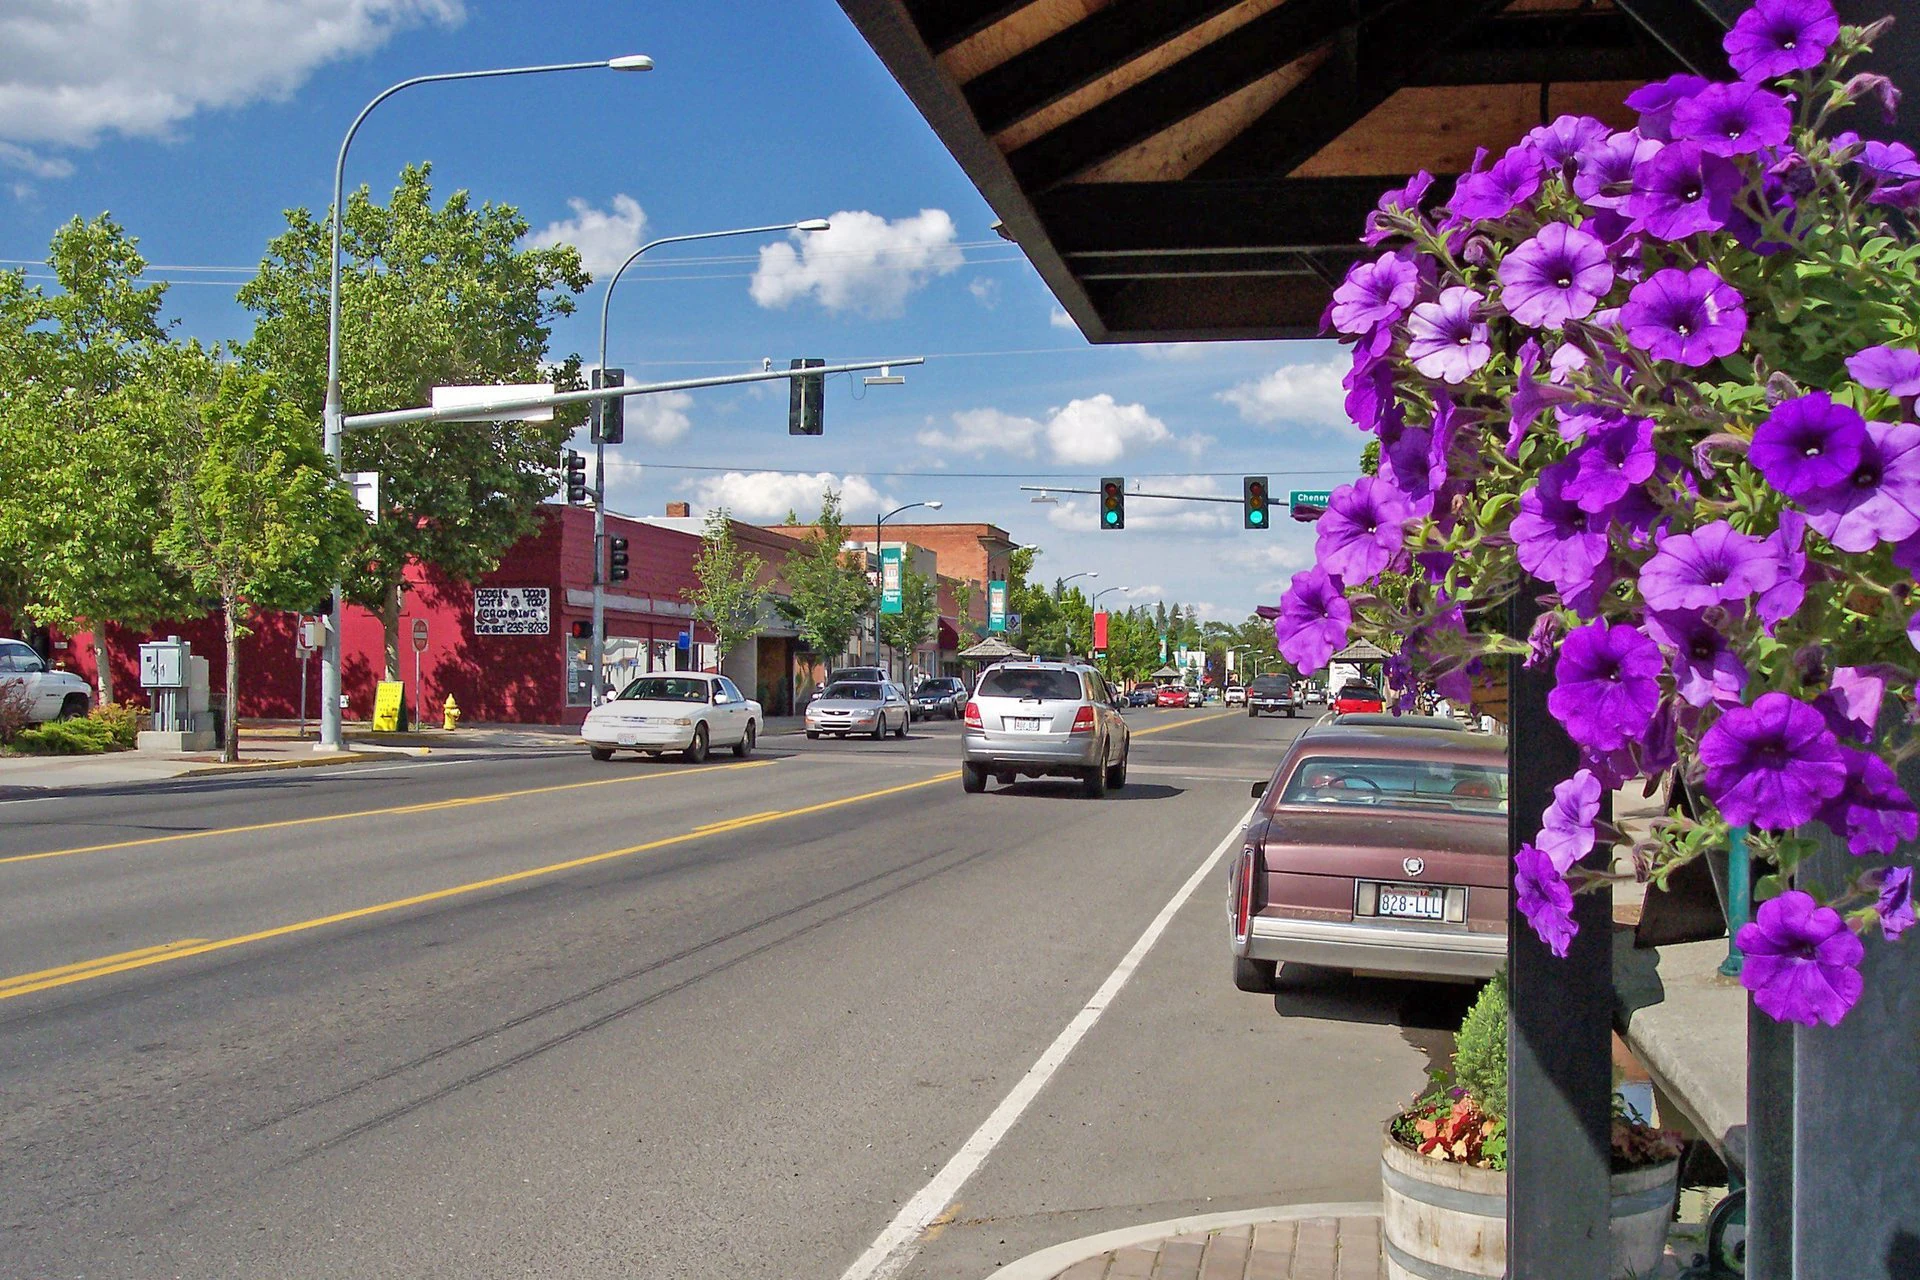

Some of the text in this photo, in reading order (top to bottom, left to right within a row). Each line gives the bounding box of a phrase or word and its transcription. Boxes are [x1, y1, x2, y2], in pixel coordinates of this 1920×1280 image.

[1297, 493, 1330, 503] Cheney
[482, 609, 537, 618] GROOMING
[1382, 895, 1439, 914] 828-LLL
